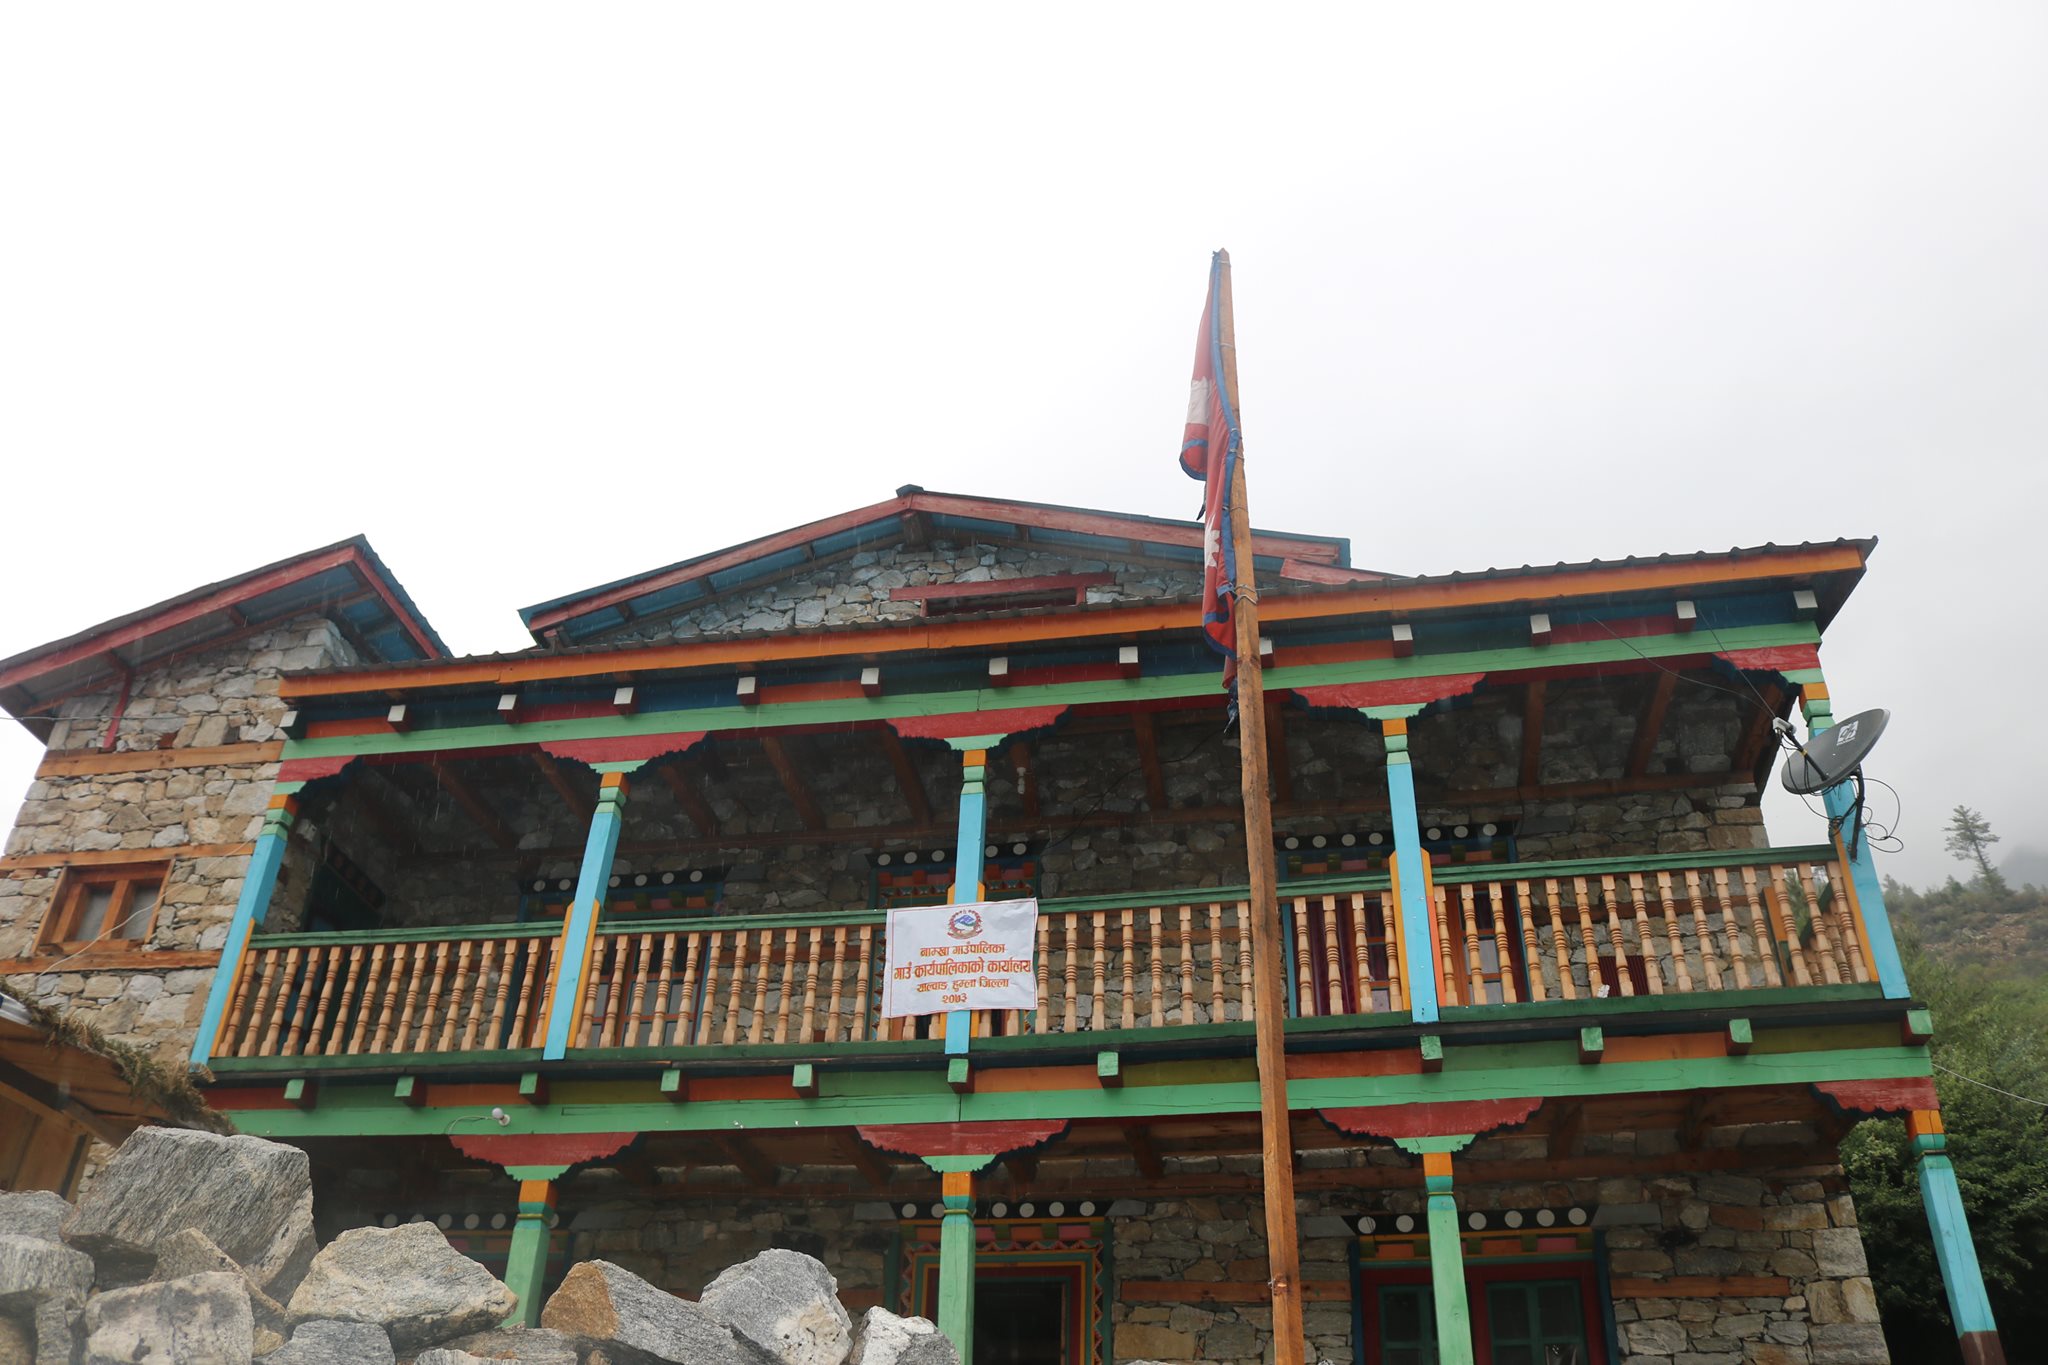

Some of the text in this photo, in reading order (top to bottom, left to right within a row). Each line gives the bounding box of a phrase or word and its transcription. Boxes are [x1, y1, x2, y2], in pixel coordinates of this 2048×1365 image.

[914, 956, 985, 978] कार्यपालिकाको
[987, 957, 1031, 973] कार्यालय
[979, 976, 1009, 988] जिल्ला
